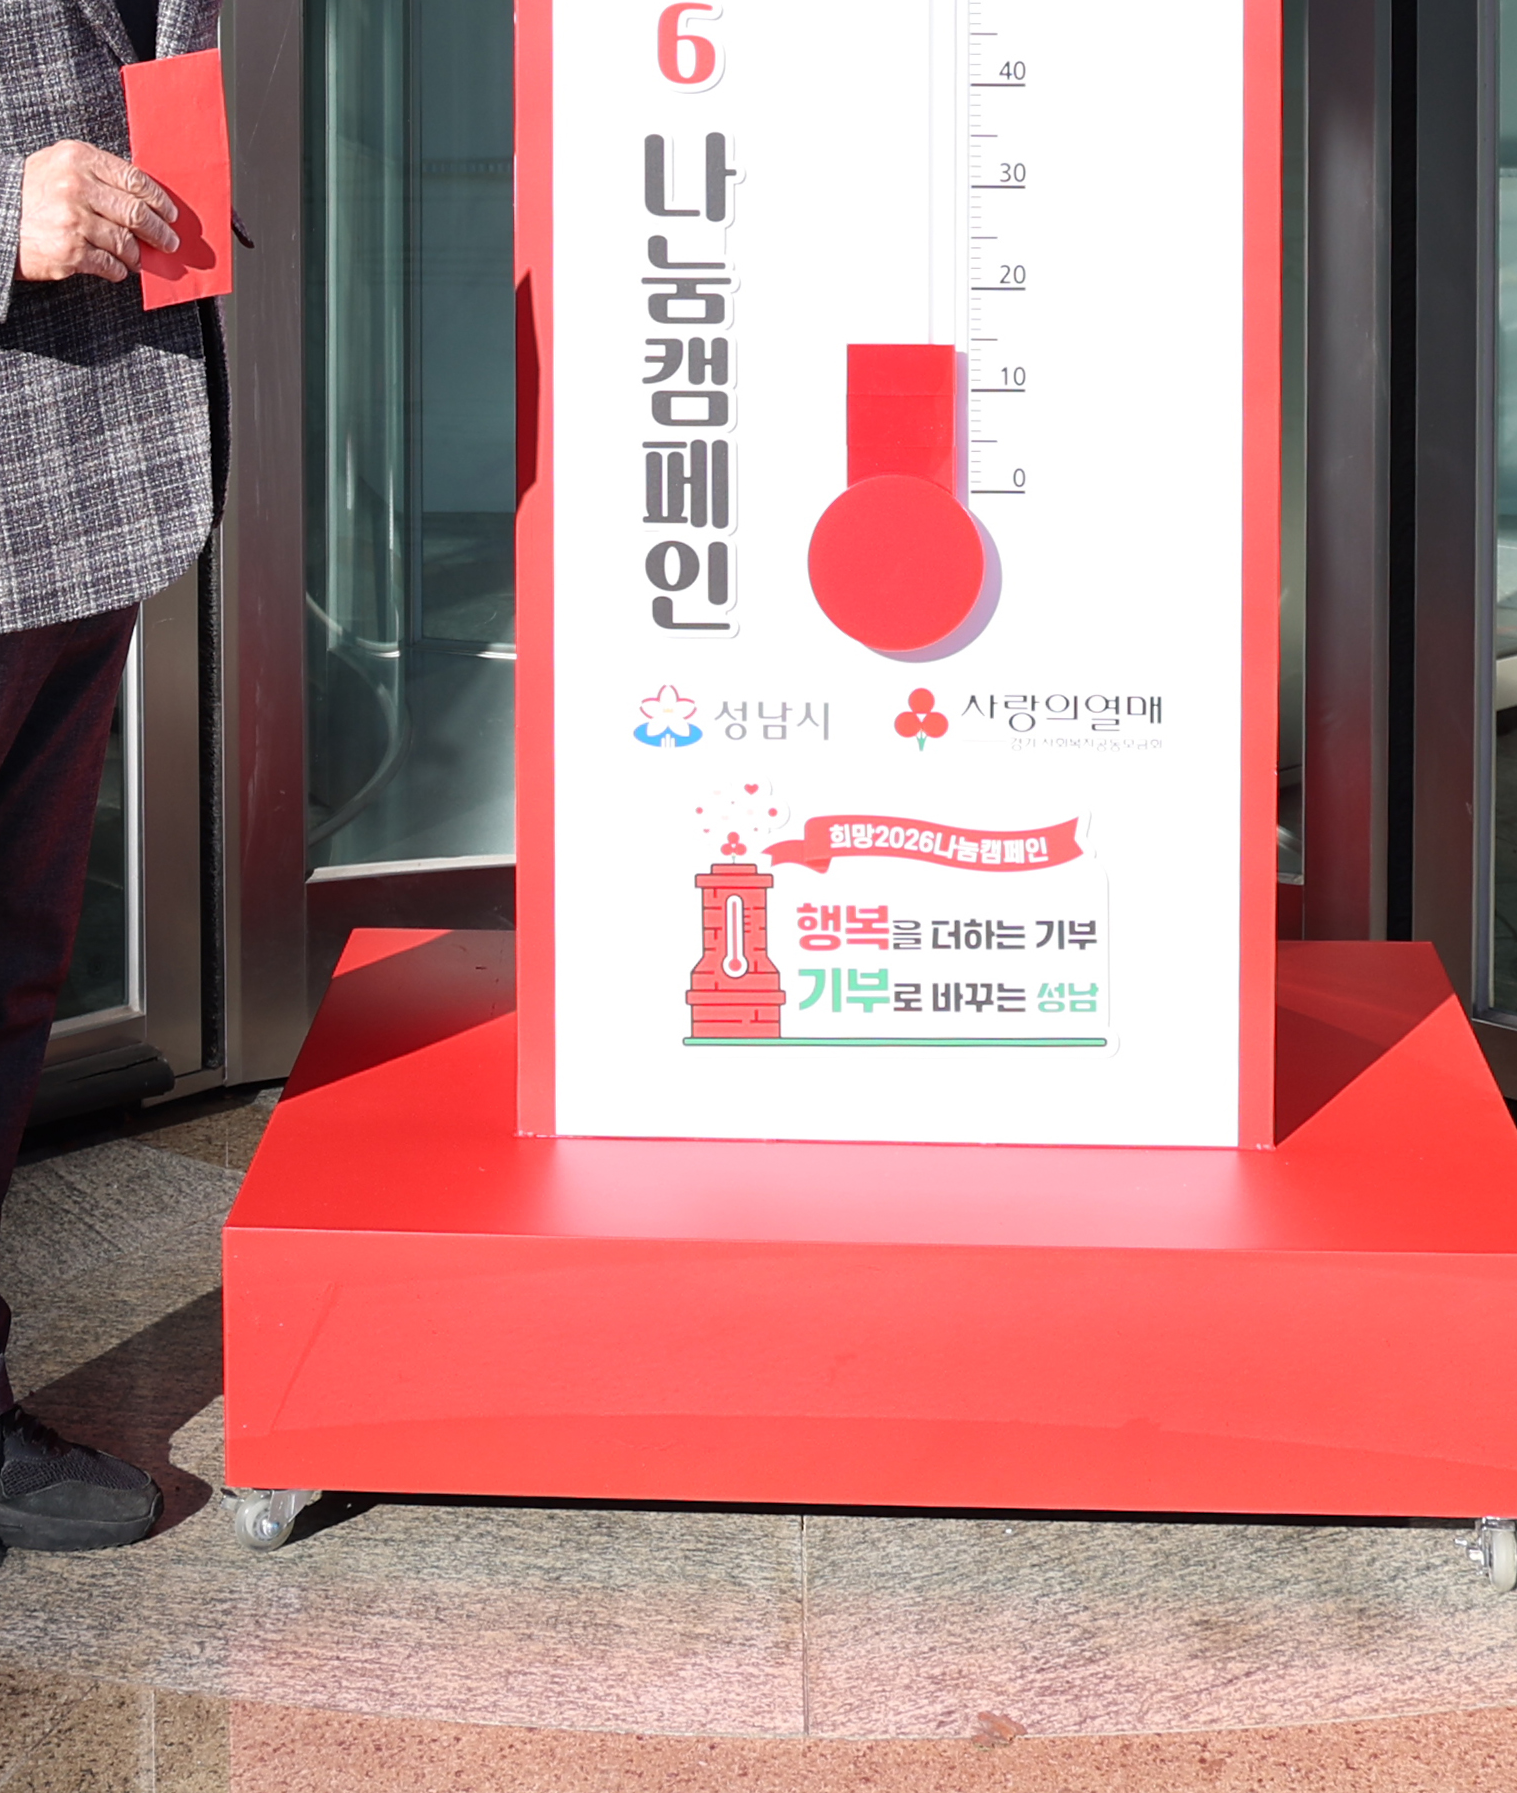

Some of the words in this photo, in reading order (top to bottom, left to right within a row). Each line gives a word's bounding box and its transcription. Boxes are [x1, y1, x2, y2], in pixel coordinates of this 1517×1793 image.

[998, 60, 1026, 81] 40
[1000, 162, 1027, 183] 30
[999, 264, 1026, 285] 20
[640, 131, 738, 631] 나눔캠페인
[1001, 366, 1026, 387] 10
[1012, 467, 1026, 488] 0
[715, 700, 830, 741] 성남시
[962, 694, 1162, 732] 사랑의열매
[829, 823, 1049, 865] 희망2026나눔캠페인
[796, 902, 922, 952] 행복을
[931, 918, 1026, 951] 더하는
[1035, 919, 1098, 951] 기부
[798, 967, 923, 1014] 기부로
[932, 982, 1027, 1013] 바꾸는
[1037, 982, 1099, 1013] 성남
